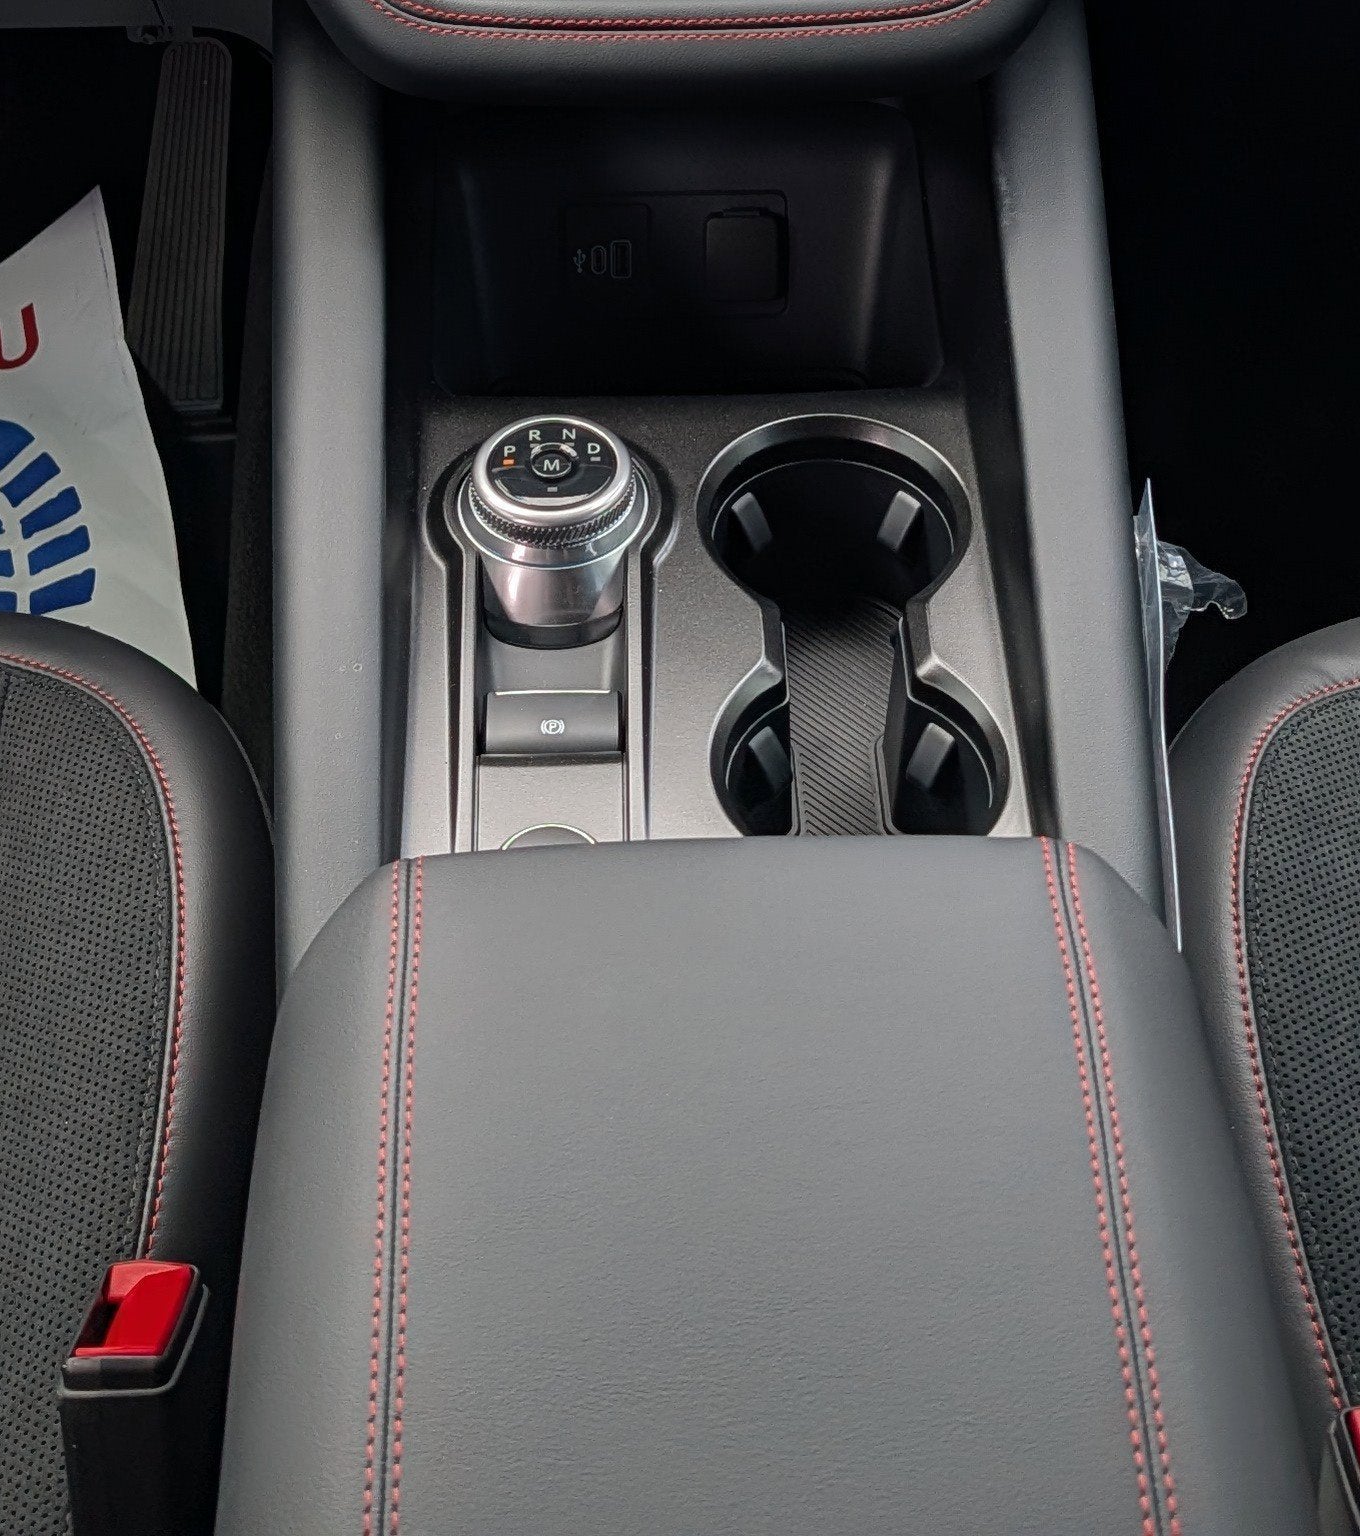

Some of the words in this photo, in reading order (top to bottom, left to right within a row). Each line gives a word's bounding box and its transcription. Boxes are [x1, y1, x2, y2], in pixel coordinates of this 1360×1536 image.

[529, 430, 541, 441] R
[562, 428, 576, 440] N
[503, 445, 516, 457] P
[587, 443, 601, 454] D
[543, 459, 560, 471] M
